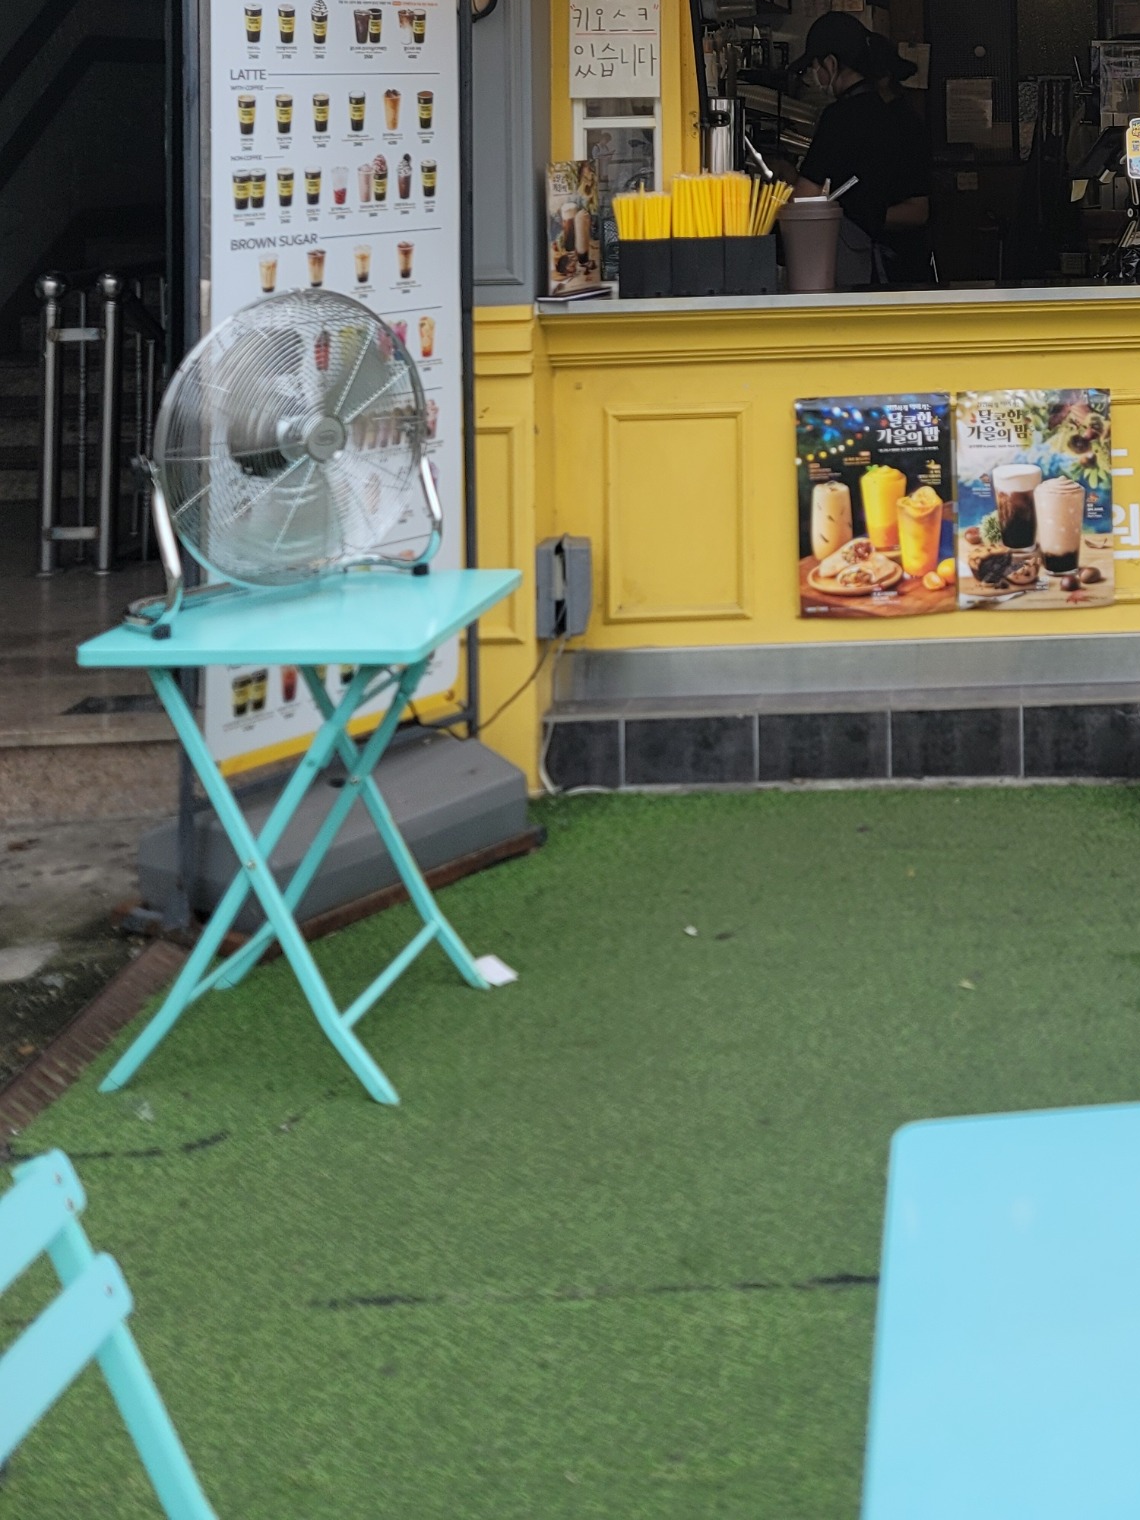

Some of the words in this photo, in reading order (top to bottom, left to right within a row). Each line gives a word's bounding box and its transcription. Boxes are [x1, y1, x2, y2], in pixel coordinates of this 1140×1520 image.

[574, 43, 657, 78] 있습니다
[230, 69, 267, 81] LATTE
[230, 237, 276, 251] BROWN
[278, 233, 319, 247] SUGAR
[887, 412, 933, 430] 달콤한
[978, 409, 1023, 427] 달콤한
[877, 428, 923, 446] 가을의
[923, 426, 940, 442] 밤
[968, 426, 1011, 442] 가을의
[1014, 424, 1028, 439] 밤
